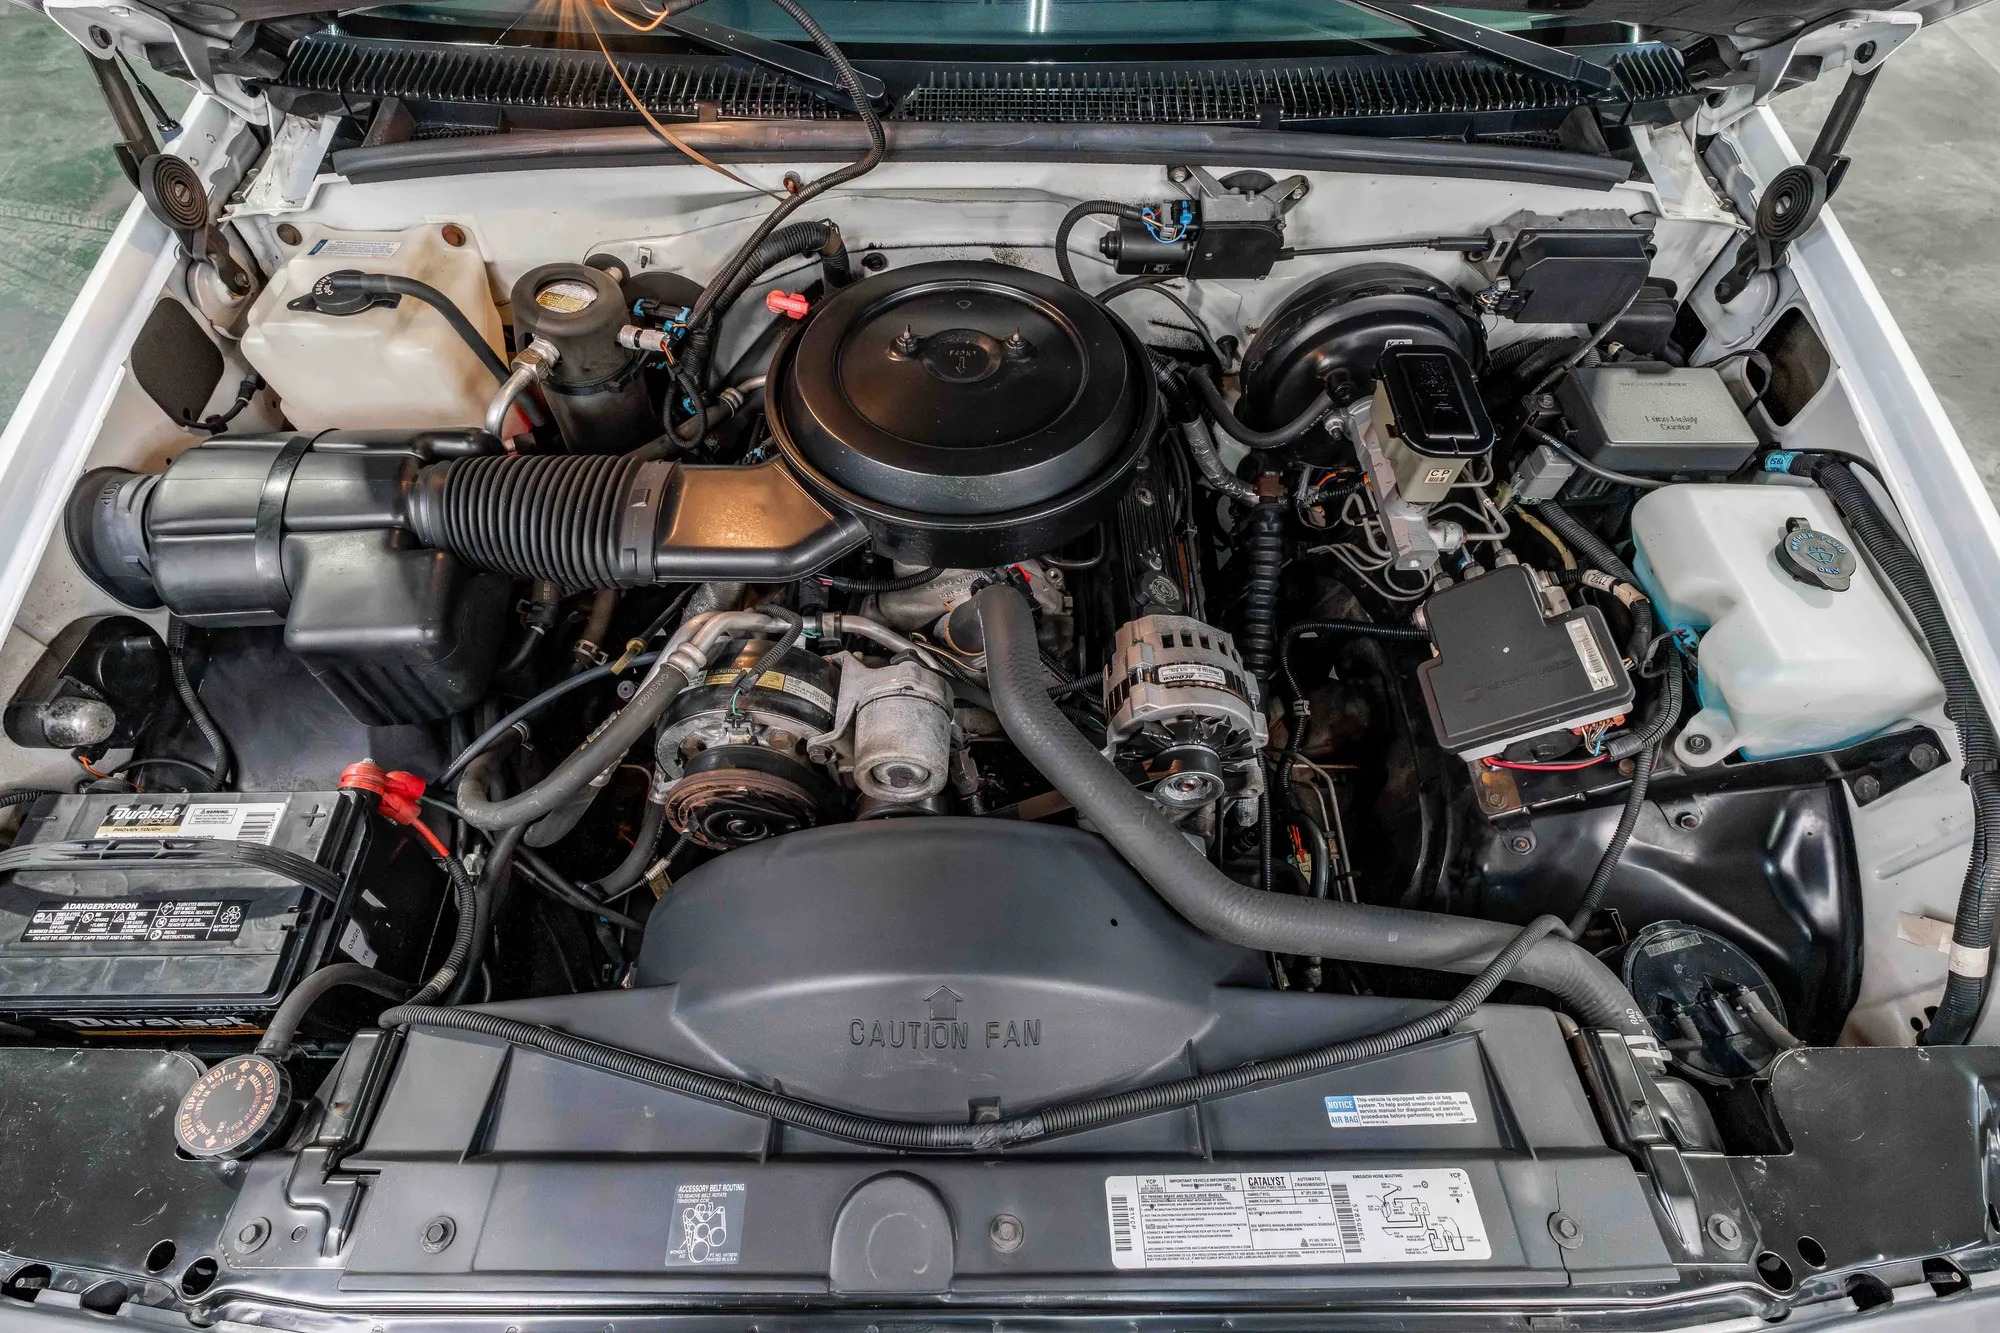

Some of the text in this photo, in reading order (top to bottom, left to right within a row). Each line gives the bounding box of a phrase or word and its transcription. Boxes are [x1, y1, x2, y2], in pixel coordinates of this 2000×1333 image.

[1791, 533, 1846, 554] WASHER FLUID
[113, 807, 180, 819] Duralast
[50, 1016, 252, 1027] Duralast
[1626, 1008, 1640, 1025] RAD
[850, 1018, 1041, 1049] CAUTION FAN
[182, 1066, 226, 1142] NEVER OPEN HOT
[1328, 1100, 1353, 1109] NOTICE
[1248, 1176, 1285, 1186] CATALYST
